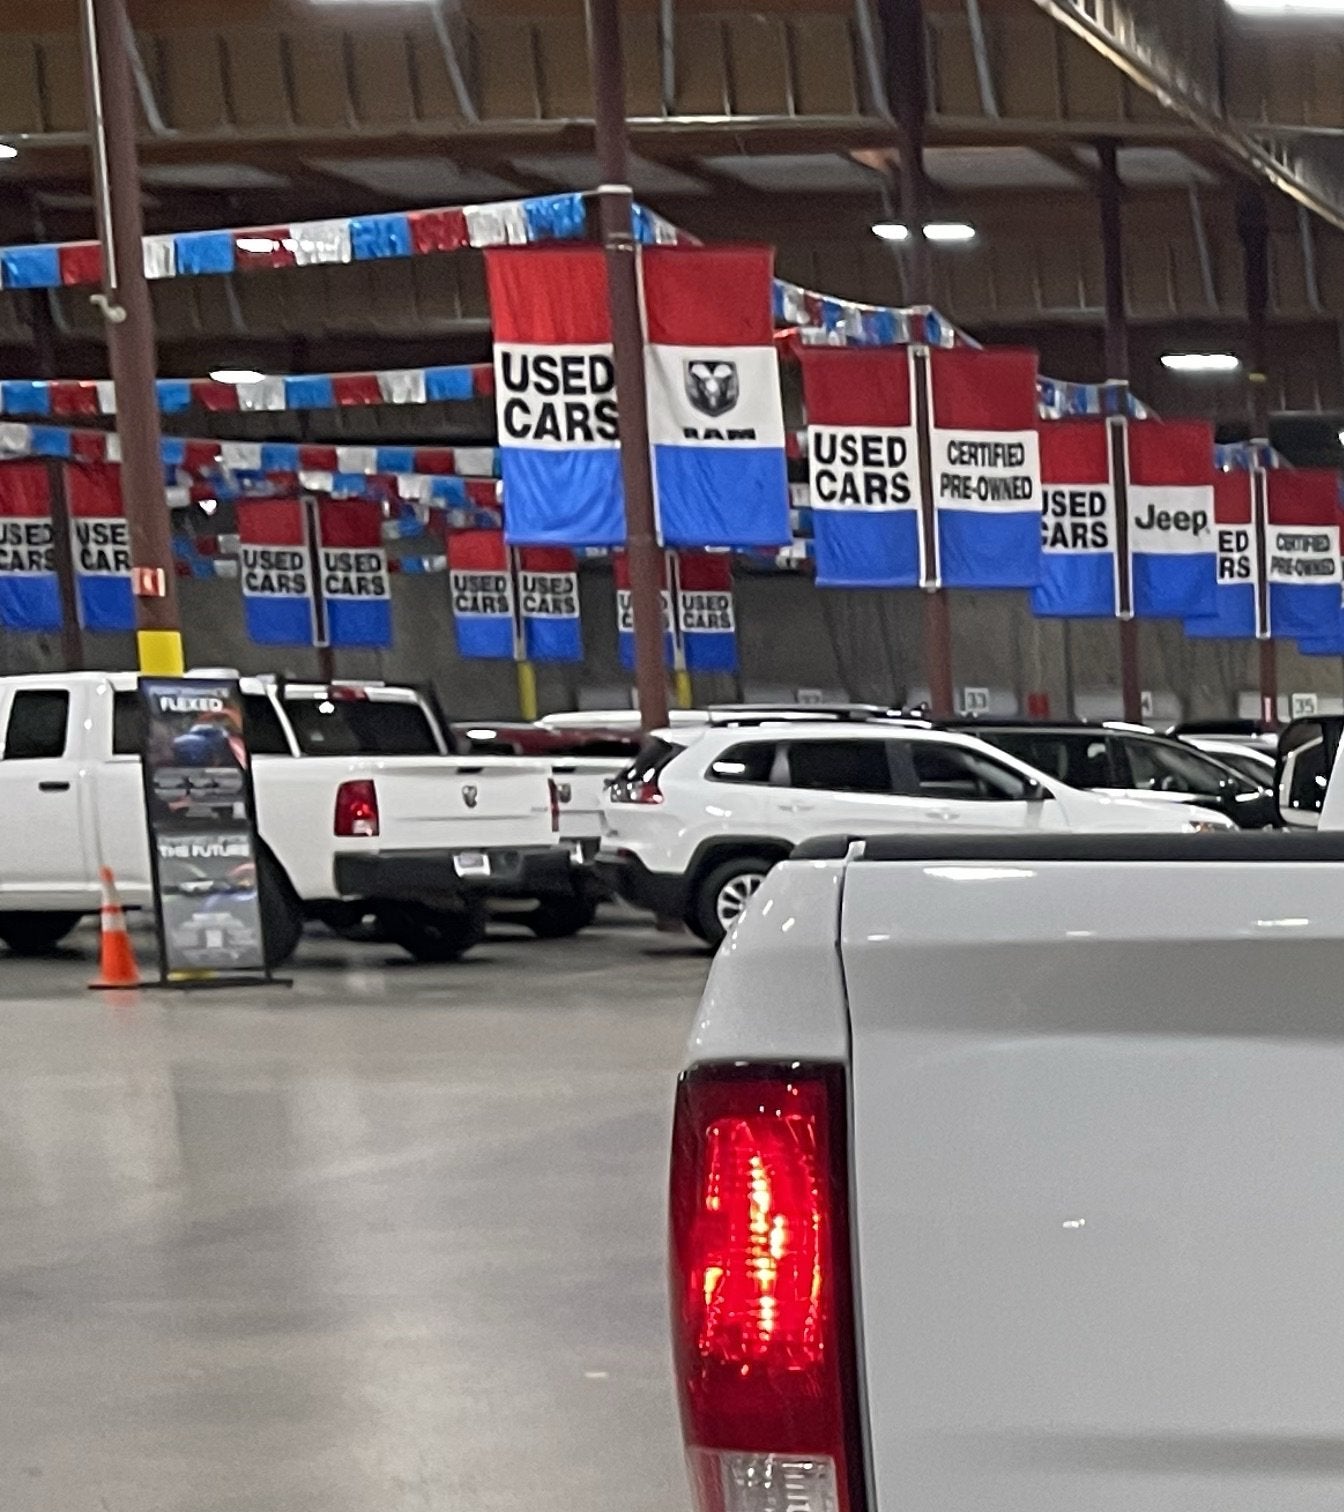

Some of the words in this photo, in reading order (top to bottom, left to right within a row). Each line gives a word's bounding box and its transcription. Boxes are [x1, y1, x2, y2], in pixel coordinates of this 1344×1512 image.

[502, 351, 614, 396] USED
[504, 398, 618, 442] CARS
[814, 432, 907, 468] USED
[947, 440, 1025, 467] CERTIFIED
[815, 469, 911, 504] CARS
[940, 472, 1032, 501] PRE-OWNED
[1135, 504, 1207, 537] Jeep
[75, 523, 128, 546] USE
[80, 550, 131, 572] CAR
[242, 549, 304, 571] USED
[324, 552, 382, 573] USED
[245, 572, 307, 594] CARS
[325, 575, 385, 596] CARS
[454, 575, 507, 593] USED
[523, 575, 574, 593] USED
[455, 594, 509, 613] CARS
[523, 595, 576, 614] CARS
[682, 594, 729, 611] USED
[683, 612, 731, 629] CARS
